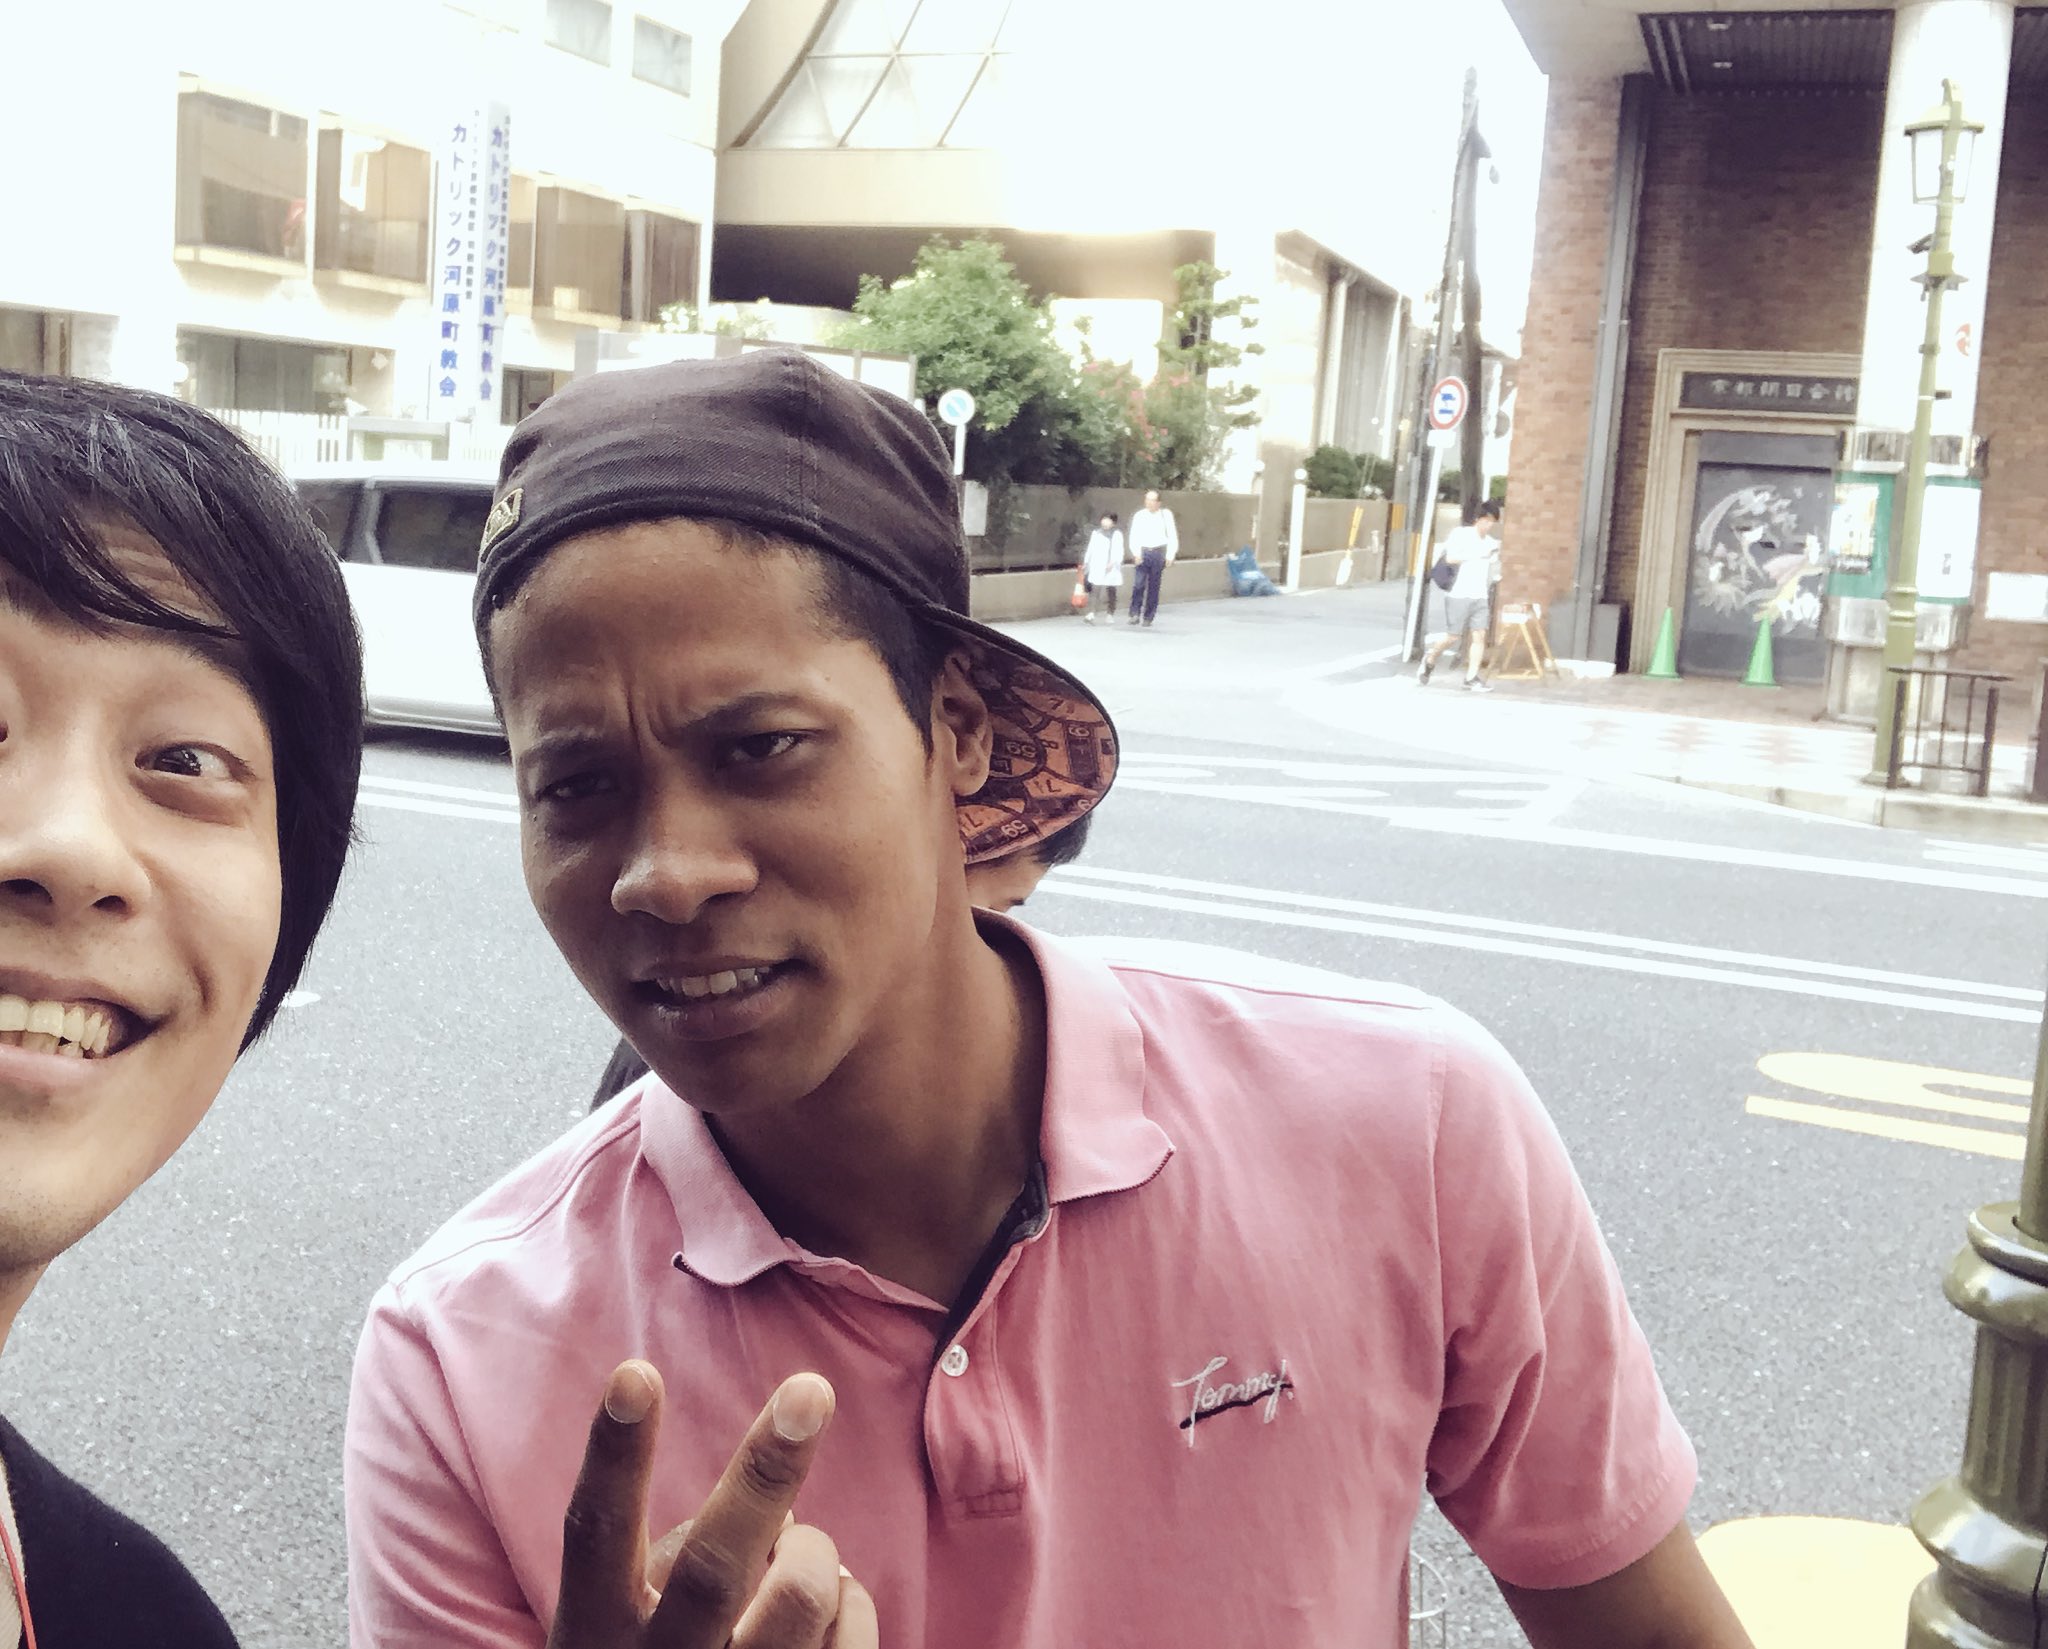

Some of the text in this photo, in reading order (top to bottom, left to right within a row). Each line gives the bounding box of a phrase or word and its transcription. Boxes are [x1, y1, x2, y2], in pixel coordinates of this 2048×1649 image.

[439, 123, 468, 398] カトリック河原町教会
